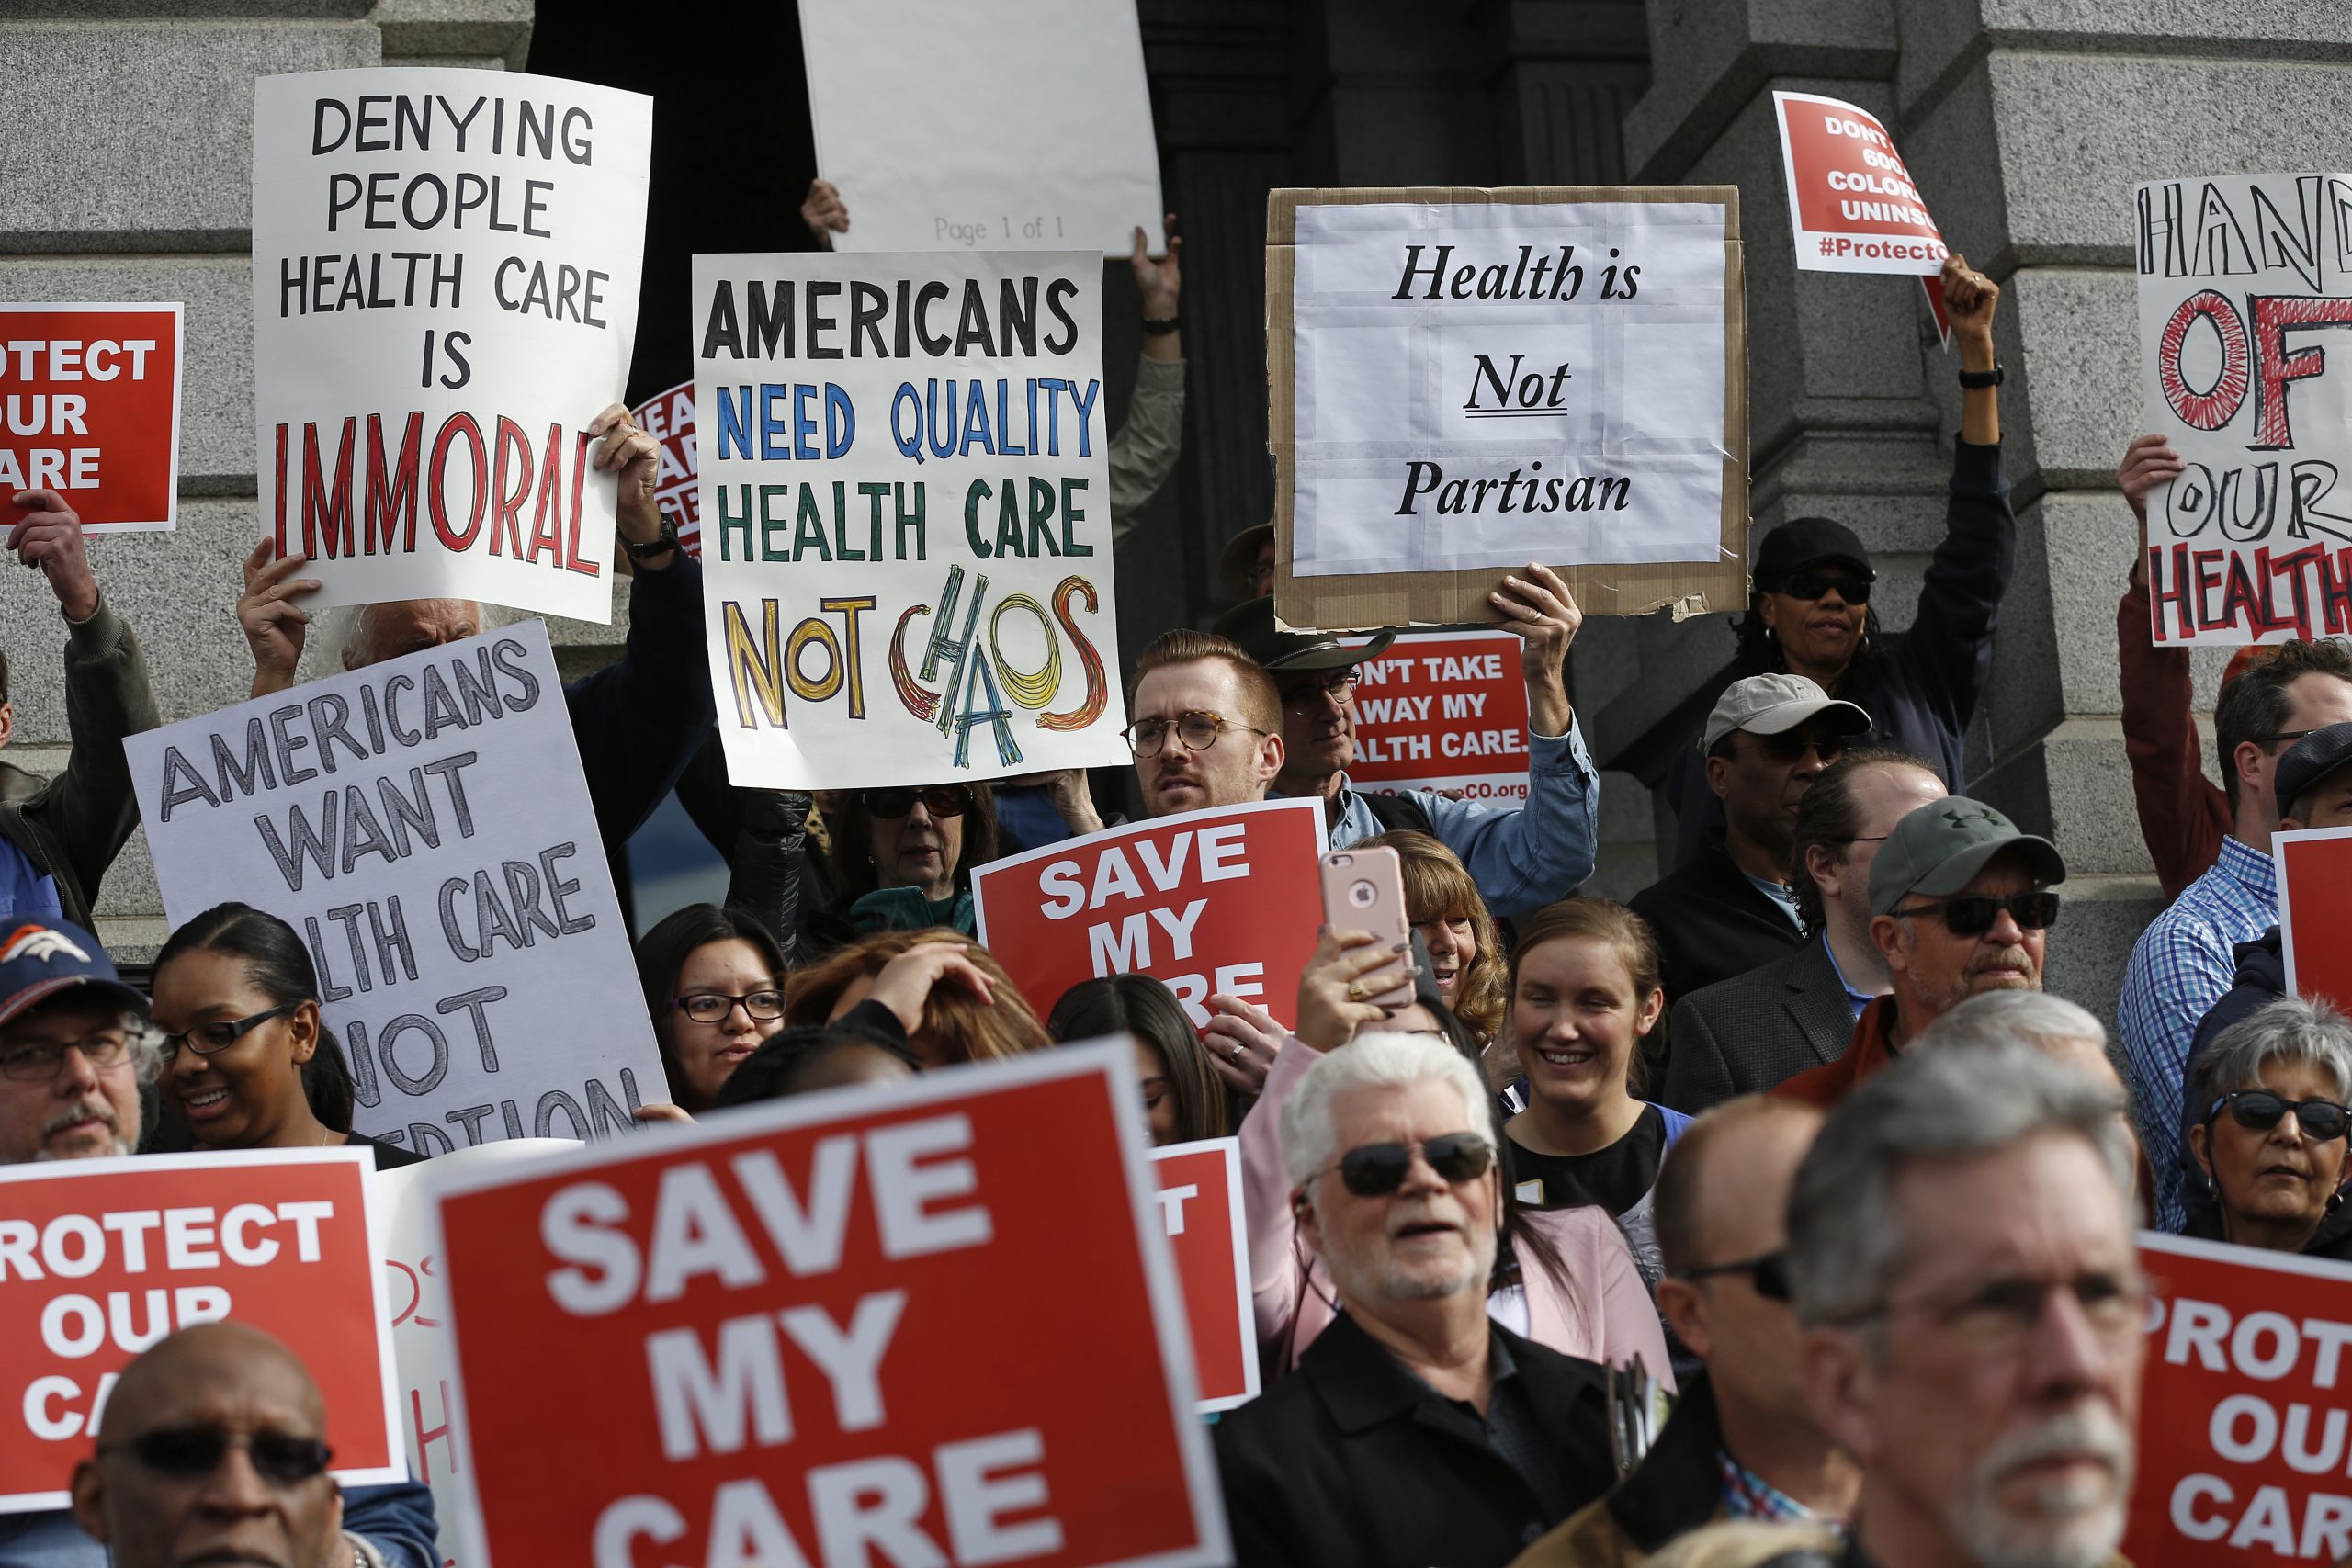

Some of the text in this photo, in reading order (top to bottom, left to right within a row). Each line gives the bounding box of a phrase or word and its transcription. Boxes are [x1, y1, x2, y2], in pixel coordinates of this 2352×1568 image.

[312, 95, 594, 166] DENYING
[1824, 116, 1888, 149] DONT
[328, 172, 554, 239] PEOPLE
[934, 215, 1064, 246] Page 1 of 1
[280, 252, 610, 329] HEALTH CARE
[1391, 244, 1642, 302] Health is
[422, 330, 472, 390] IS
[701, 276, 1080, 360] AMERICANS
[0, 340, 156, 382] TECT
[1463, 353, 1572, 411] Not
[0, 394, 89, 436] UR
[716, 378, 1101, 465] NEED QUALITY
[275, 411, 602, 578] IMMORAL
[717, 480, 926, 562] HEALTH
[964, 476, 1095, 558] CARE
[1394, 460, 1632, 516] Partisan
[2166, 459, 2352, 544] OUR
[2148, 541, 2352, 643] HEALTH
[722, 563, 1109, 770] NOT CHAOS
[1422, 653, 1504, 682] TAKE
[1442, 693, 1488, 720] MY
[160, 638, 540, 822] AMERICANS
[1440, 728, 1529, 759] CARE.
[254, 750, 478, 893] WANT
[1039, 822, 1250, 920] SAVE
[304, 841, 596, 1007] LTH CARE
[1088, 898, 1209, 979] MY
[352, 985, 508, 1108] NOT
[540, 1112, 994, 1317] SAVE
[645, 1289, 908, 1462] MY
[2208, 1393, 2352, 1479] OU
[593, 1426, 1065, 1568] CARE
